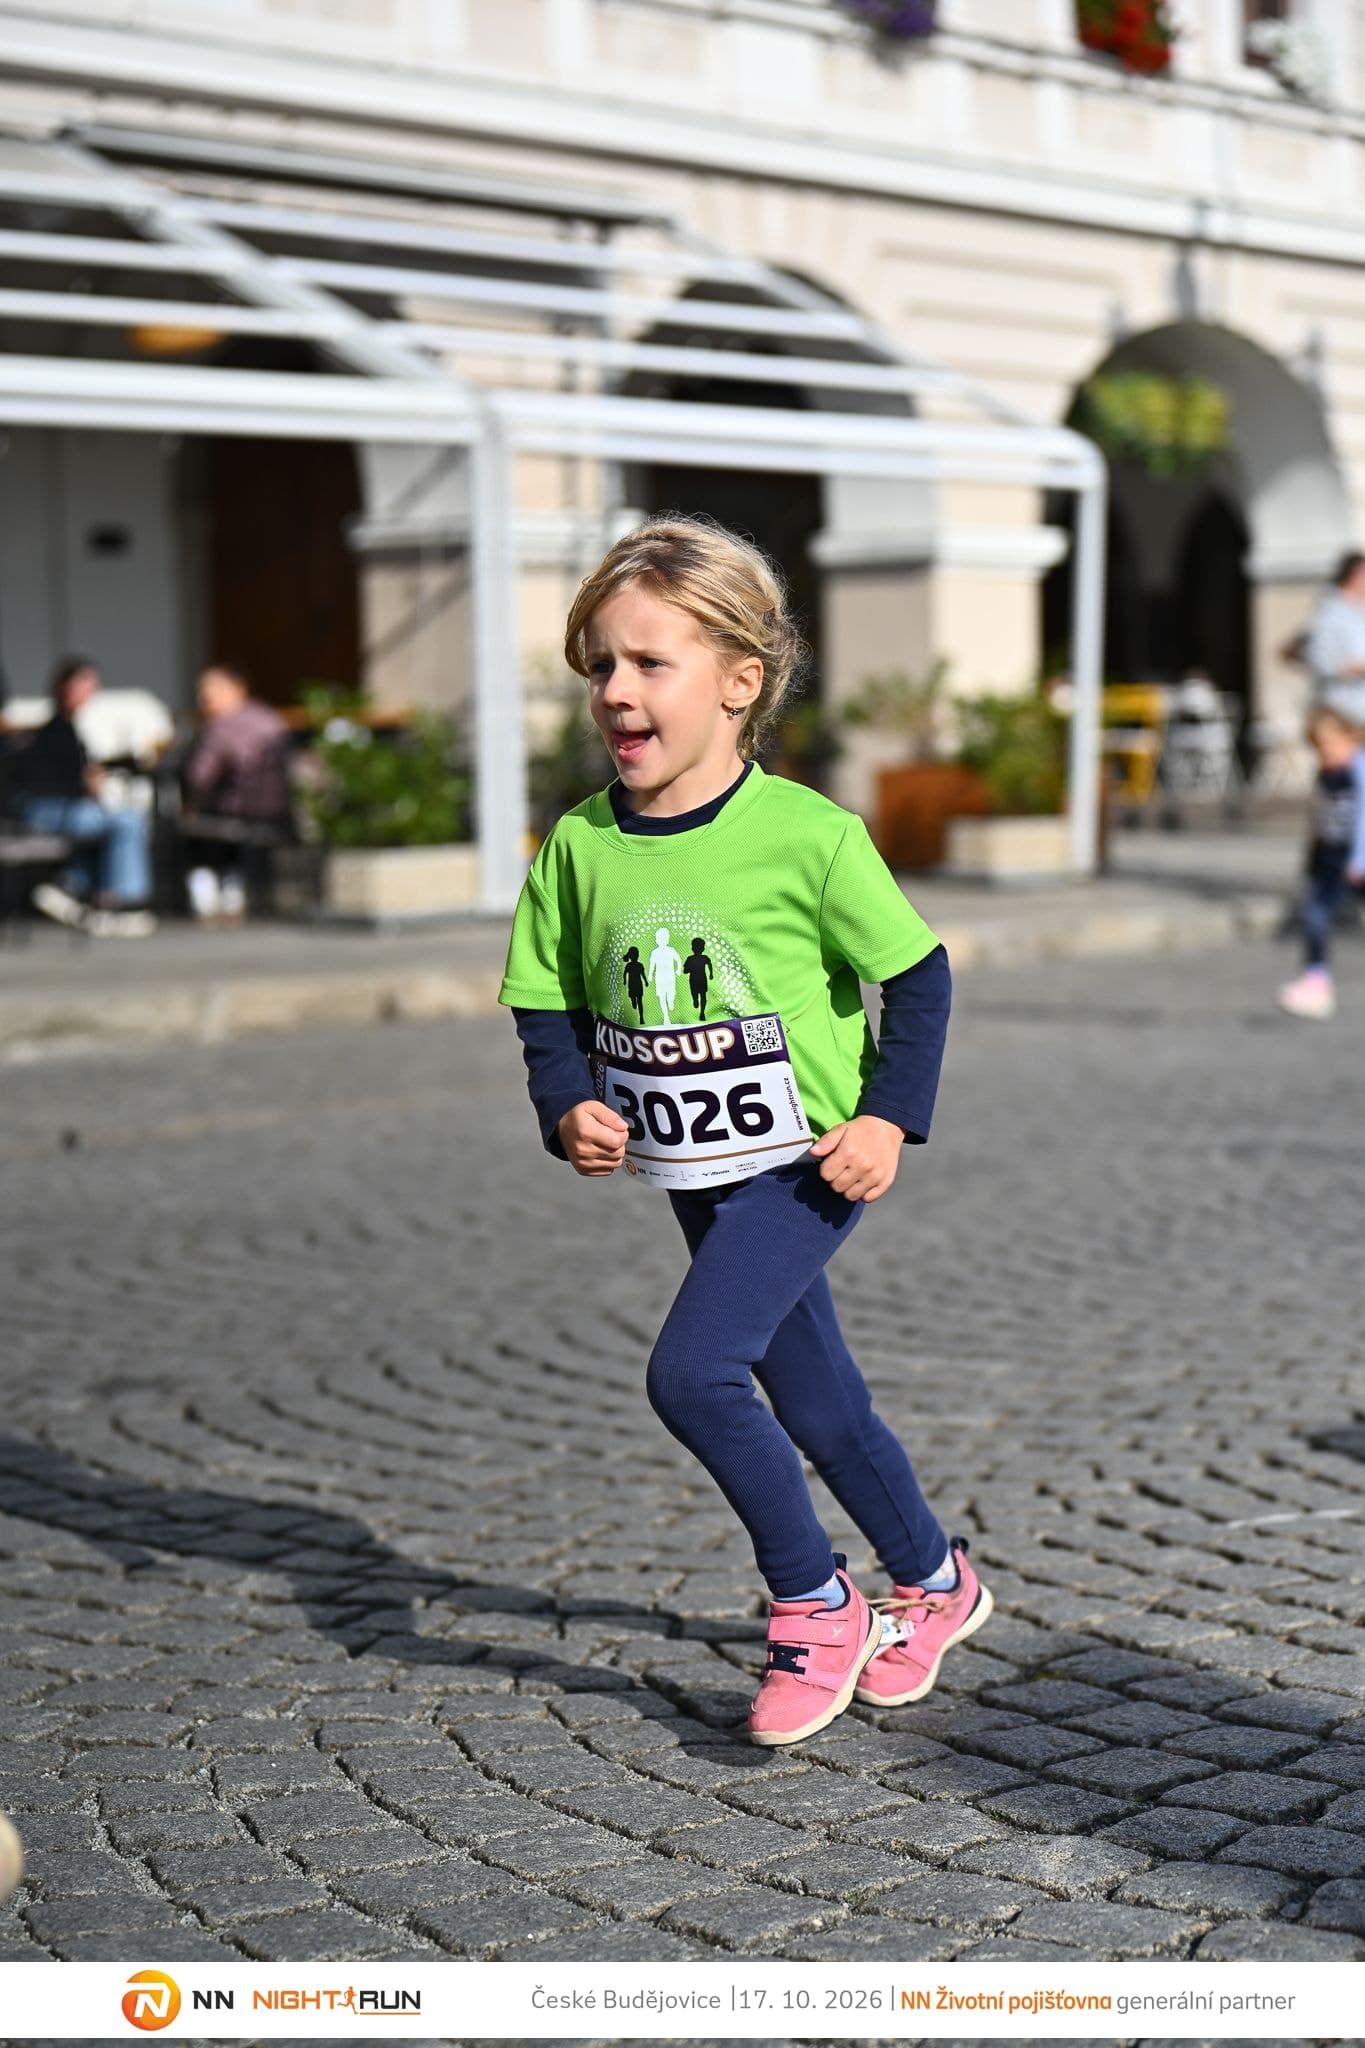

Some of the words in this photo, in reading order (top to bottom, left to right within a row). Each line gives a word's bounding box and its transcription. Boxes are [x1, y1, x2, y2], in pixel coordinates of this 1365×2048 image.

[596, 1061, 605, 1098] 2026
[783, 1077, 804, 1131] www.nightrun.cz
[612, 1082, 774, 1146] 3026
